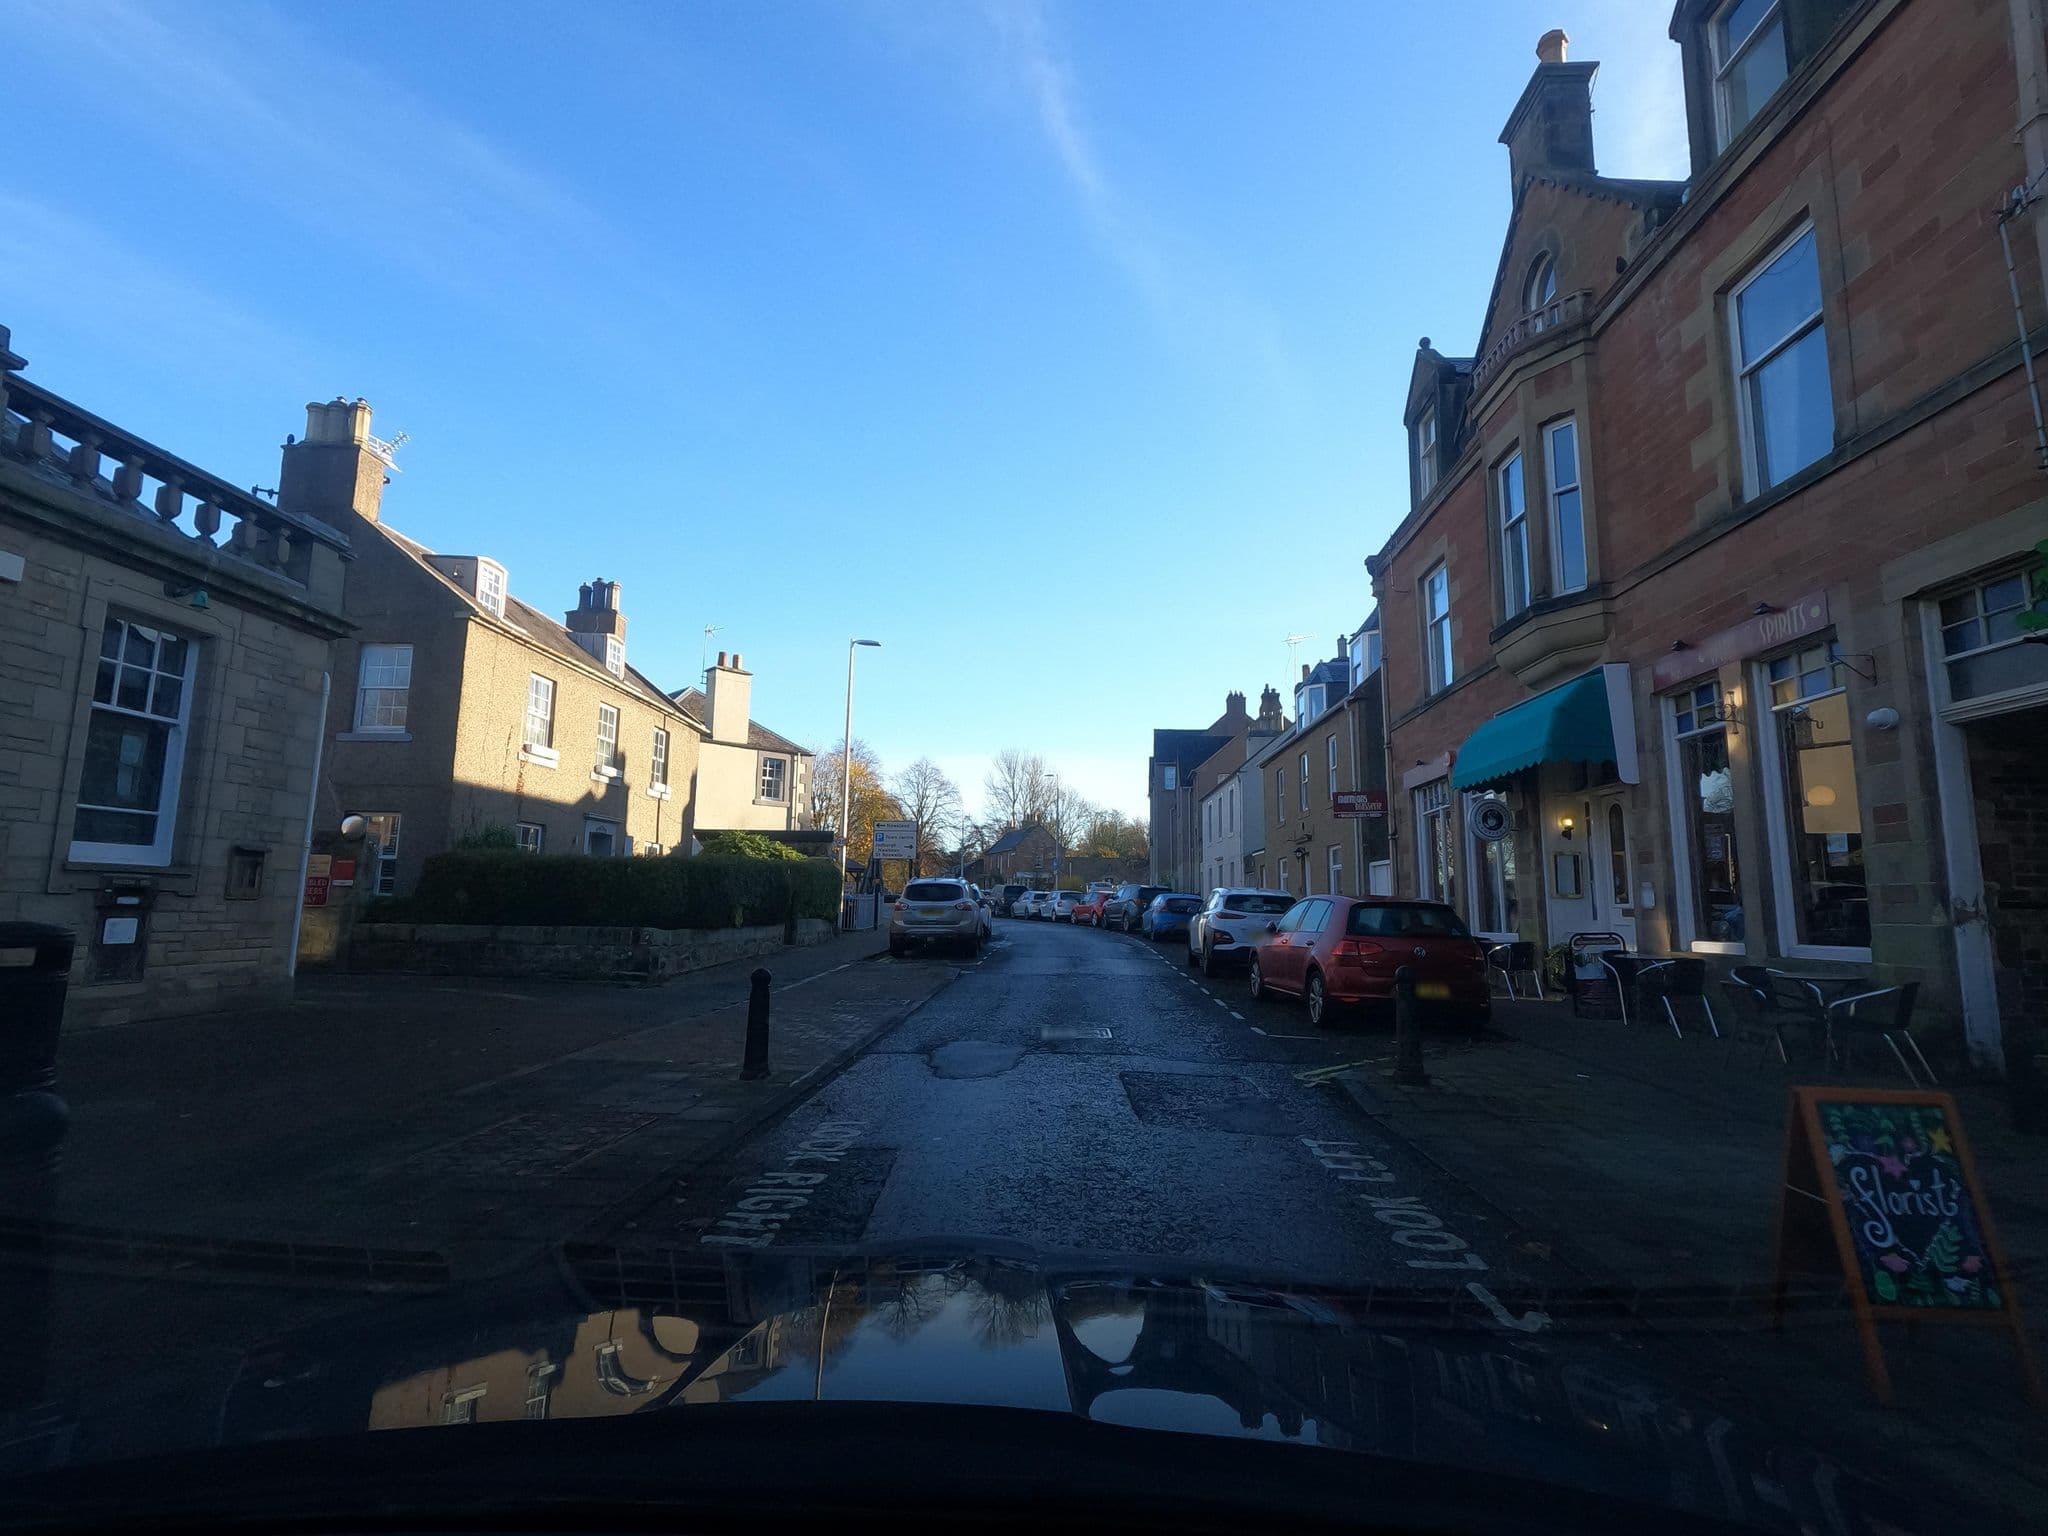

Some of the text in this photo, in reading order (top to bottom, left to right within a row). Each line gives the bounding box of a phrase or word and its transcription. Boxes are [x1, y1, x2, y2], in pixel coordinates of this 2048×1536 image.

[1758, 603, 1807, 644] SPIRITS
[700, 1172, 830, 1248] RIGHT
[1360, 1194, 1490, 1271] LOOK
